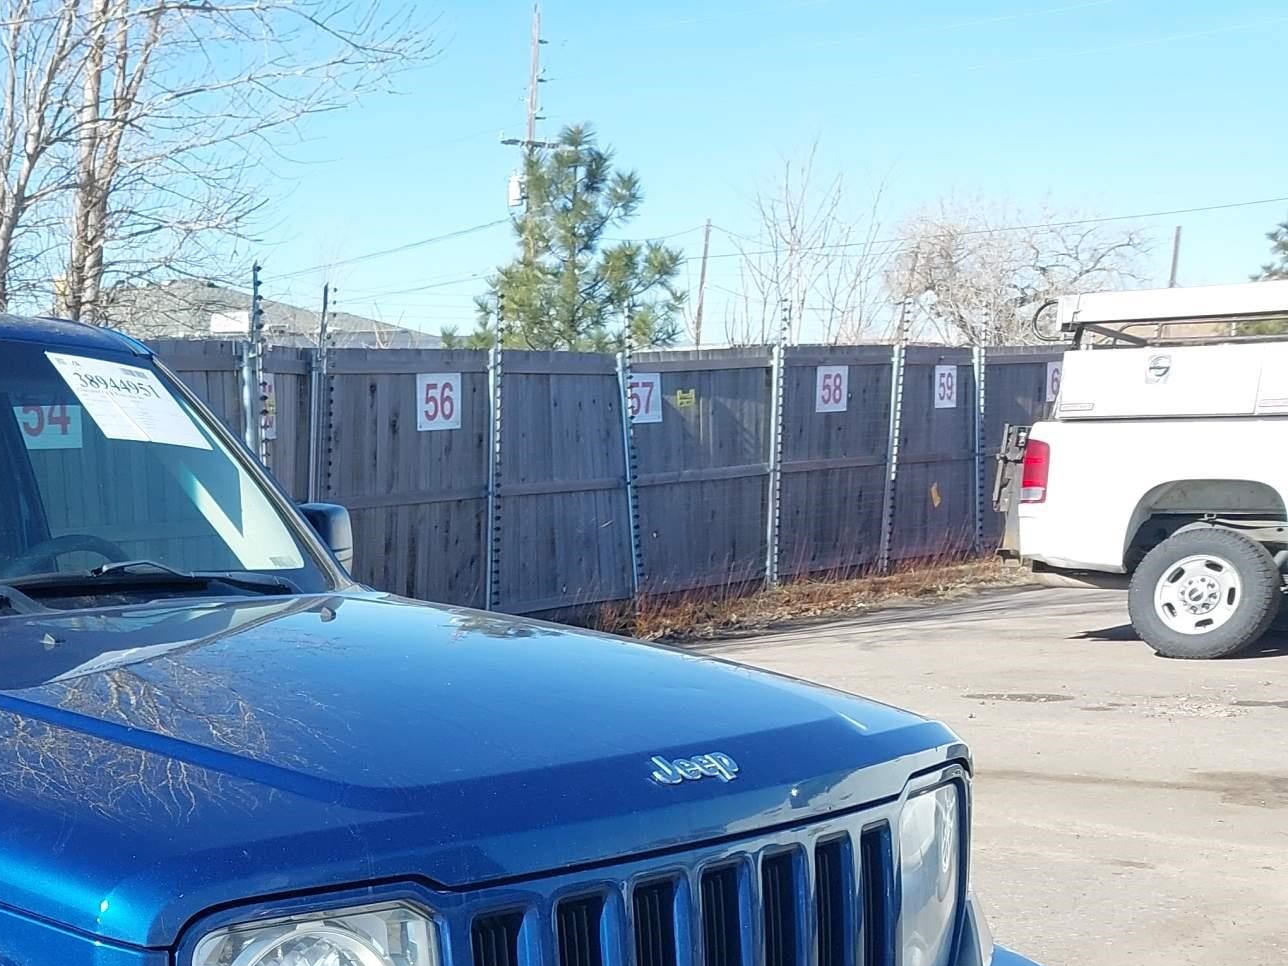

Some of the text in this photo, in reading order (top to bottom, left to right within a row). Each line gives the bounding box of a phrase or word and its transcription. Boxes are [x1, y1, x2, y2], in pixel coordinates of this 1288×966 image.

[73, 372, 161, 399] 38944951
[821, 373, 843, 405] 58
[938, 371, 954, 401] 59
[1051, 368, 1061, 395] 6
[423, 381, 454, 421] 56
[629, 381, 655, 416] 57
[22, 394, 71, 437] 54
[649, 752, 740, 784] Jeep
